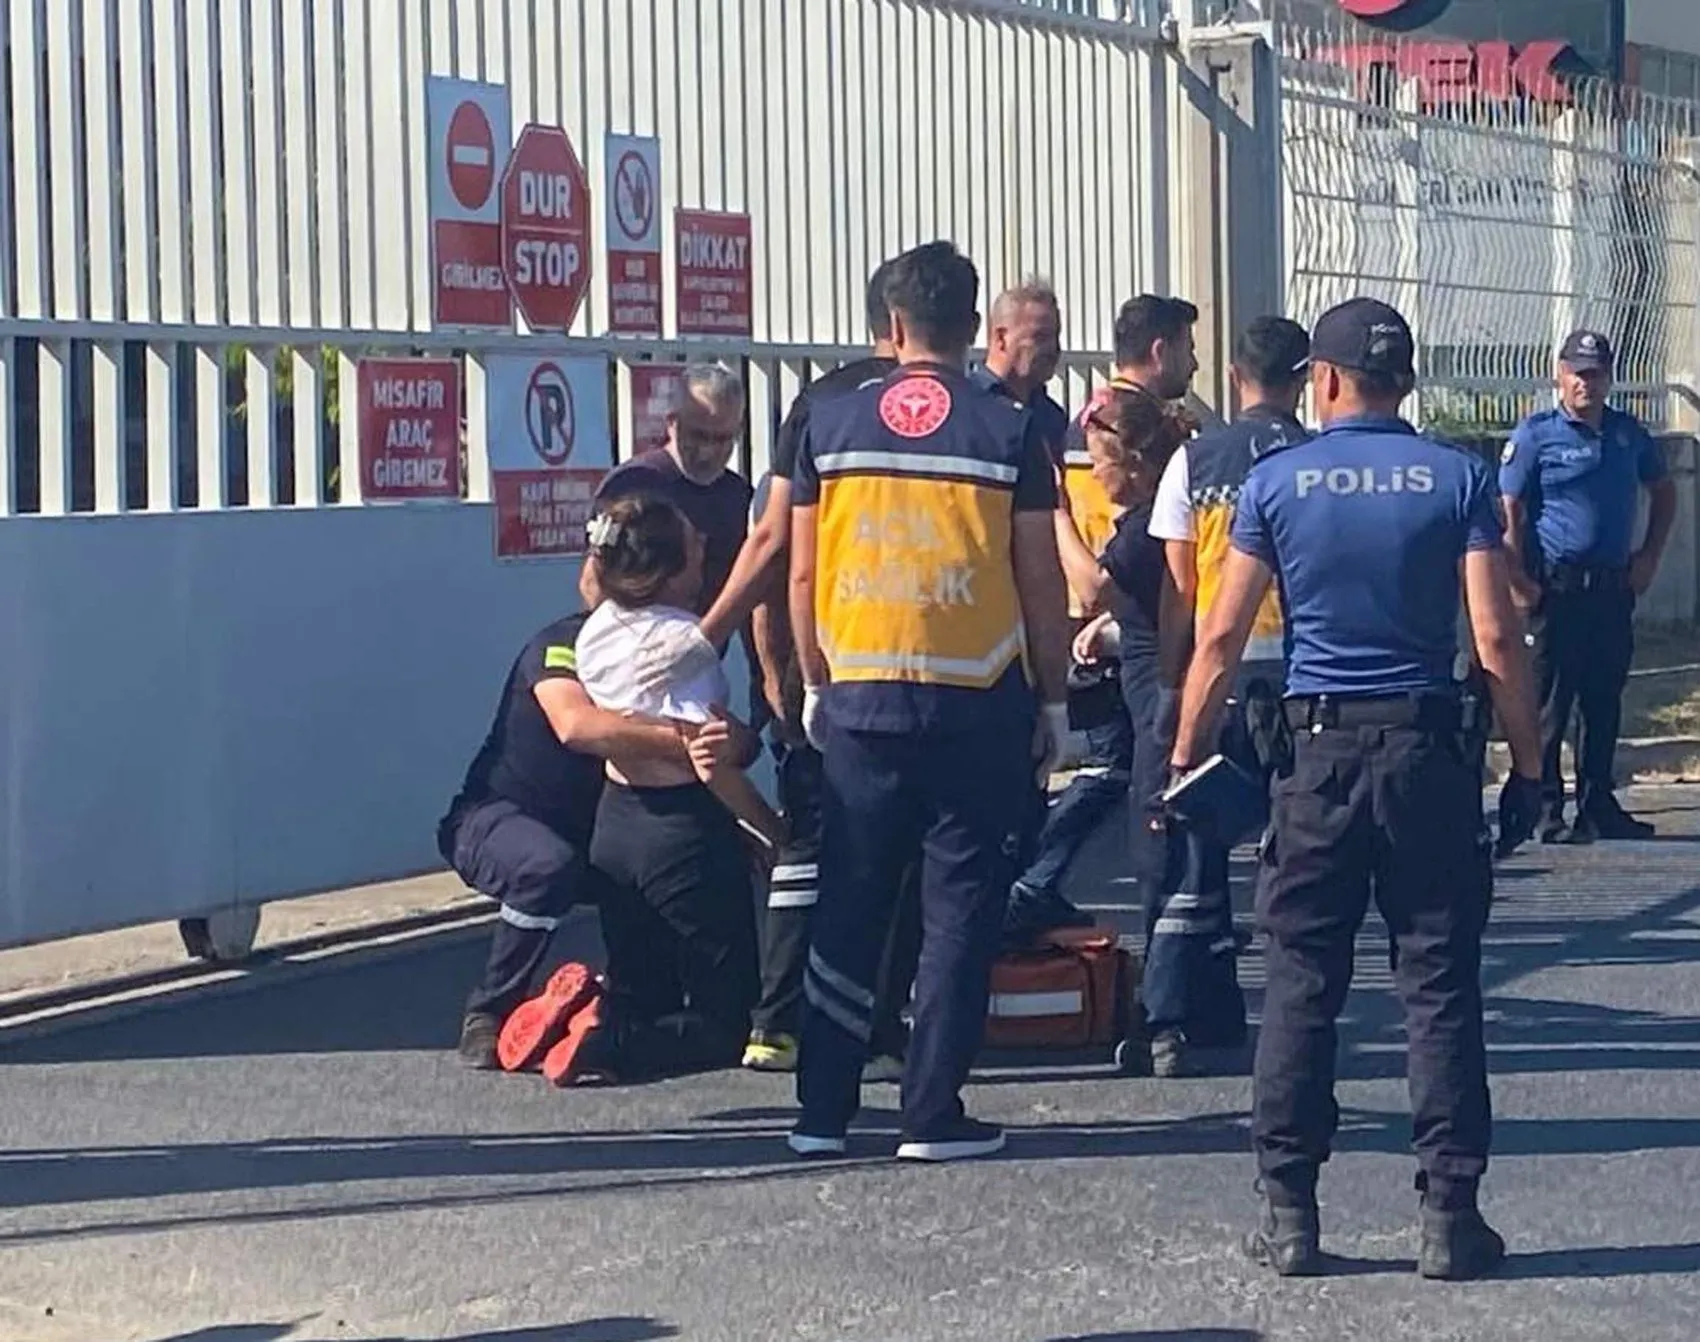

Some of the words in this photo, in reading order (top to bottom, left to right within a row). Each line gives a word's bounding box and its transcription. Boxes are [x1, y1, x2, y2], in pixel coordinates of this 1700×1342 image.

[520, 170, 572, 219] DUR
[515, 239, 579, 287] STOP
[386, 418, 433, 453] ARAÇ
[373, 451, 449, 488] GİREMEZ
